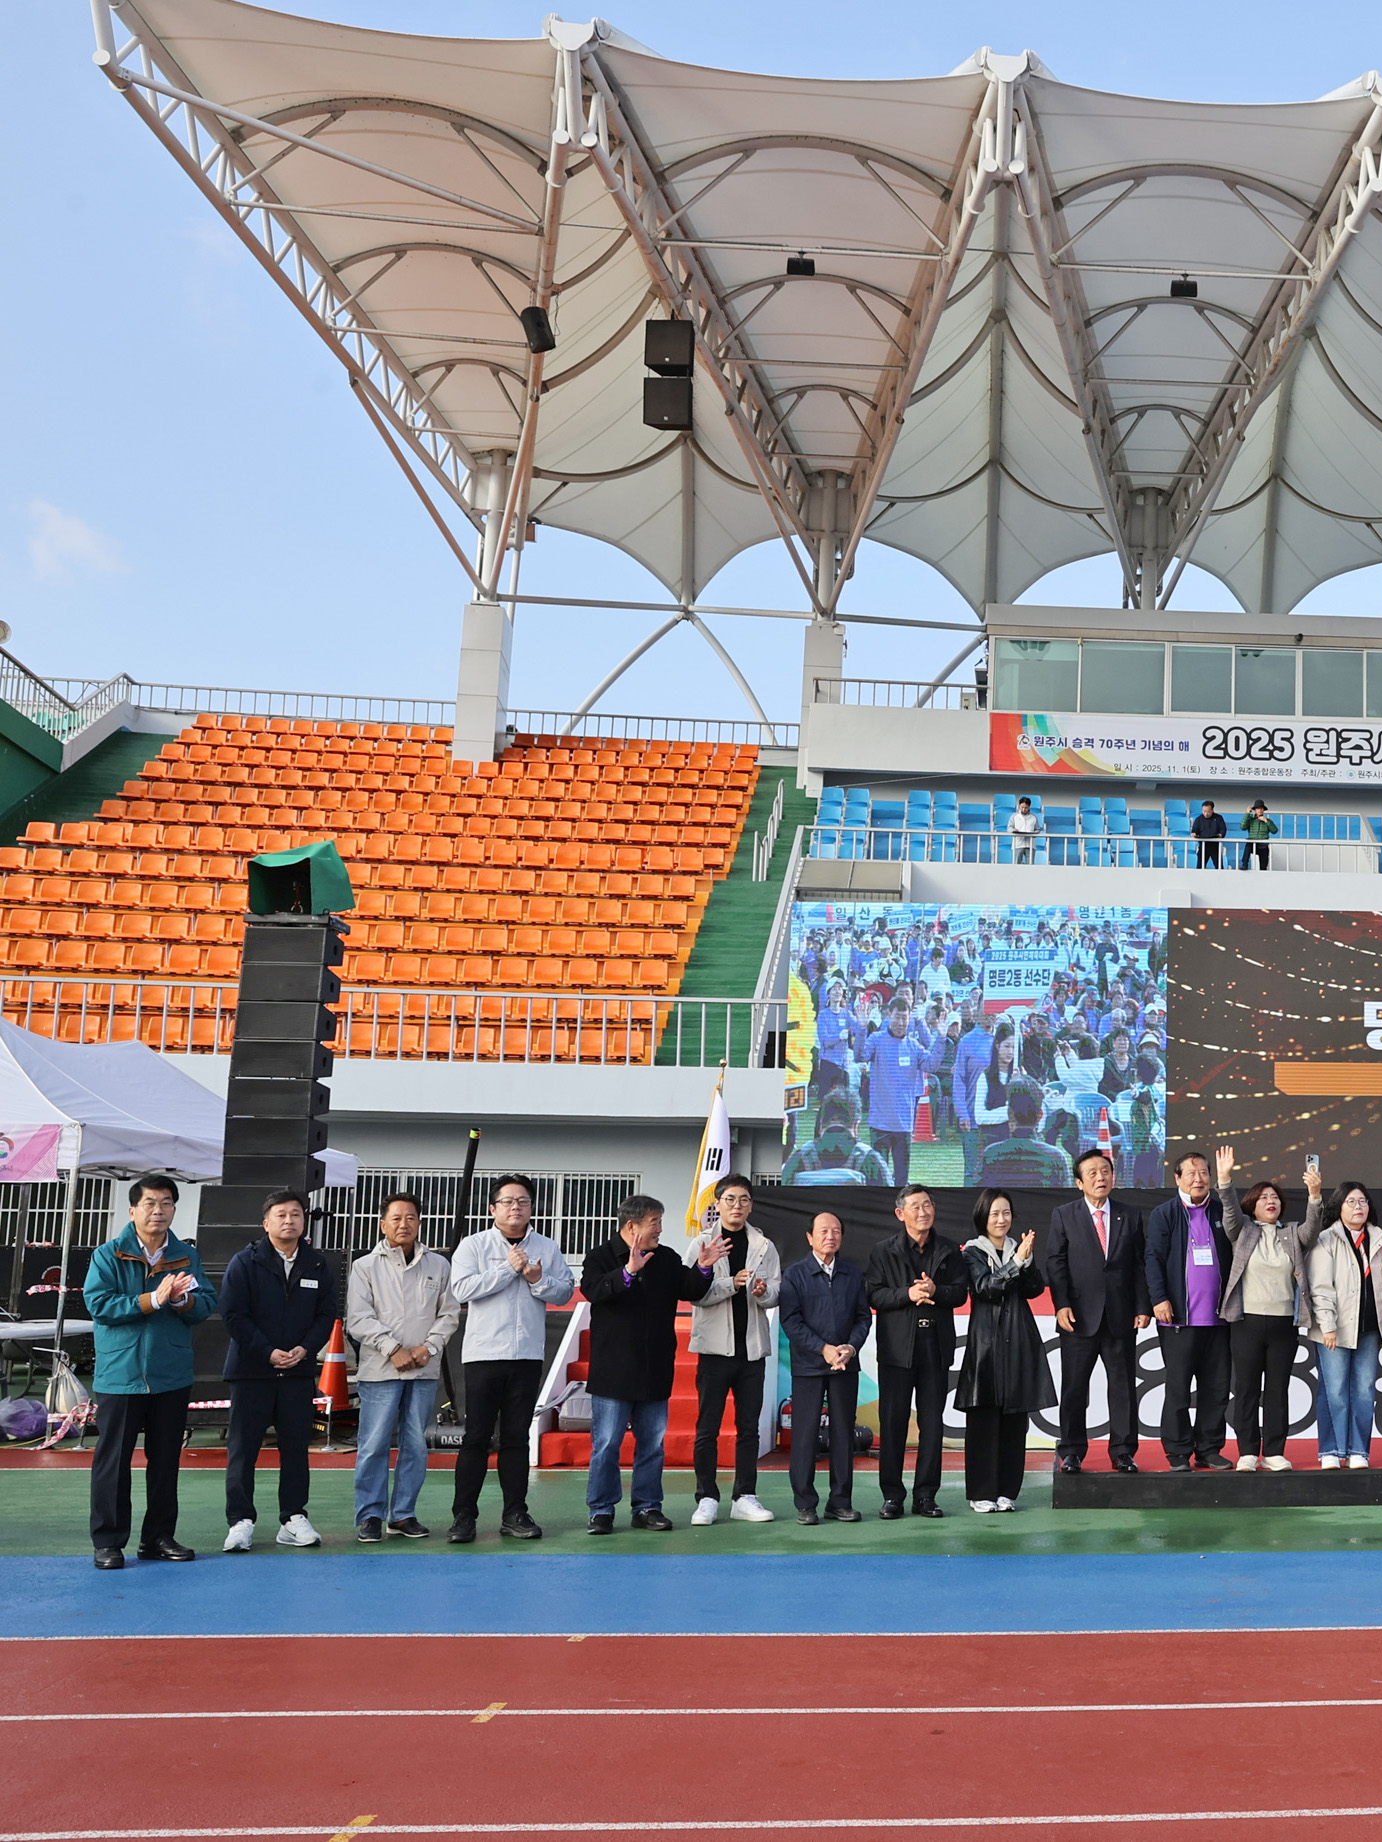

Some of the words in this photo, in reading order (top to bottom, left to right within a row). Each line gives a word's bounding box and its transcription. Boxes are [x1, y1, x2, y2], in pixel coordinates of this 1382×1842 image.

[1034, 736, 1068, 748] 원주시
[1072, 737, 1095, 749] 승격
[1099, 738, 1137, 750] 70주년
[1142, 739, 1174, 752] 기념의
[1178, 740, 1190, 752] 해
[1203, 726, 1295, 762] 2025
[1237, 767, 1293, 777] 원주종합운동장
[989, 969, 1022, 988] 명륜2동
[1024, 968, 1051, 987] 선수단
